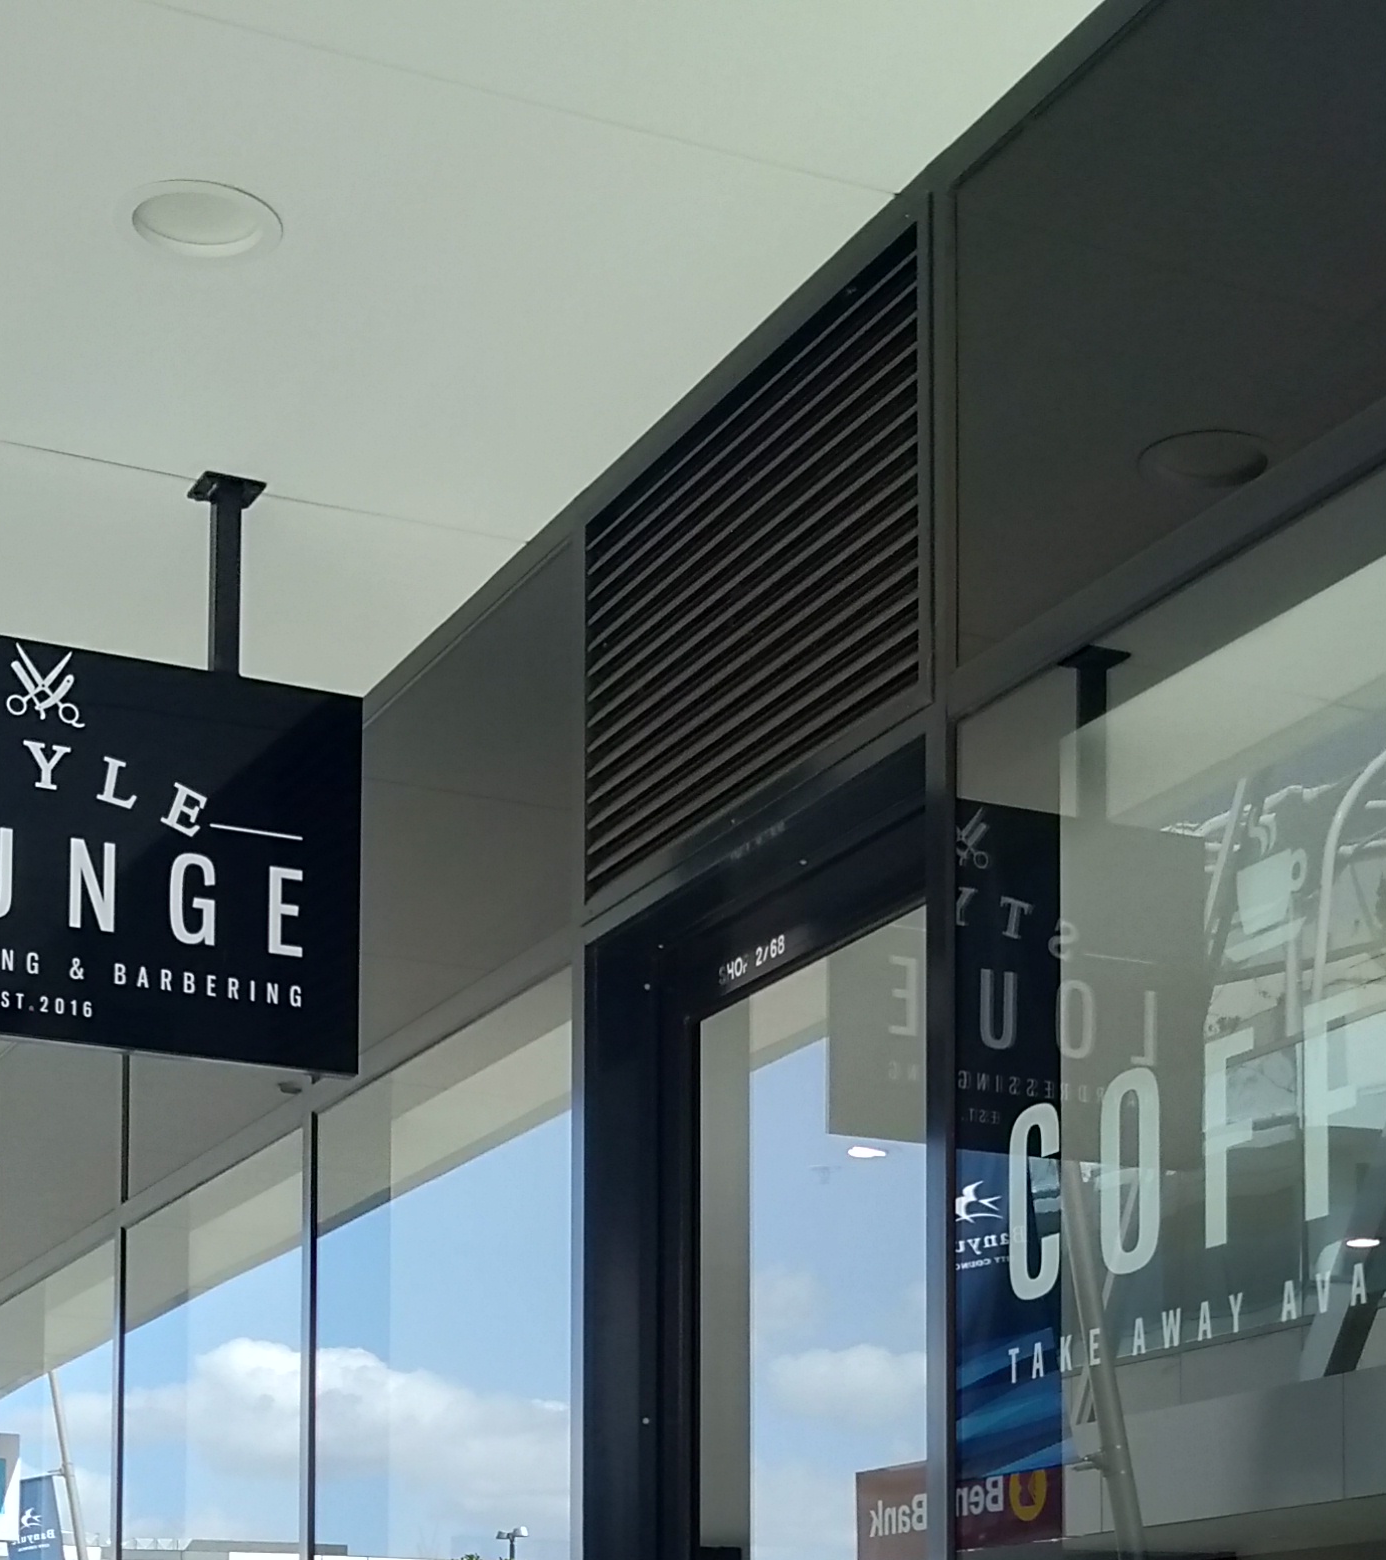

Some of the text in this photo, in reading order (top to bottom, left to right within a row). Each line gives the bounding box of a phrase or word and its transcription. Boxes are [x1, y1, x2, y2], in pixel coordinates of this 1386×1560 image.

[755, 934, 786, 968] 2/68
[69, 957, 85, 981] &
[114, 962, 304, 1009] BARBERING
[1008, 1326, 1101, 1384] TAKE
[1132, 1292, 1243, 1356] AWAY
